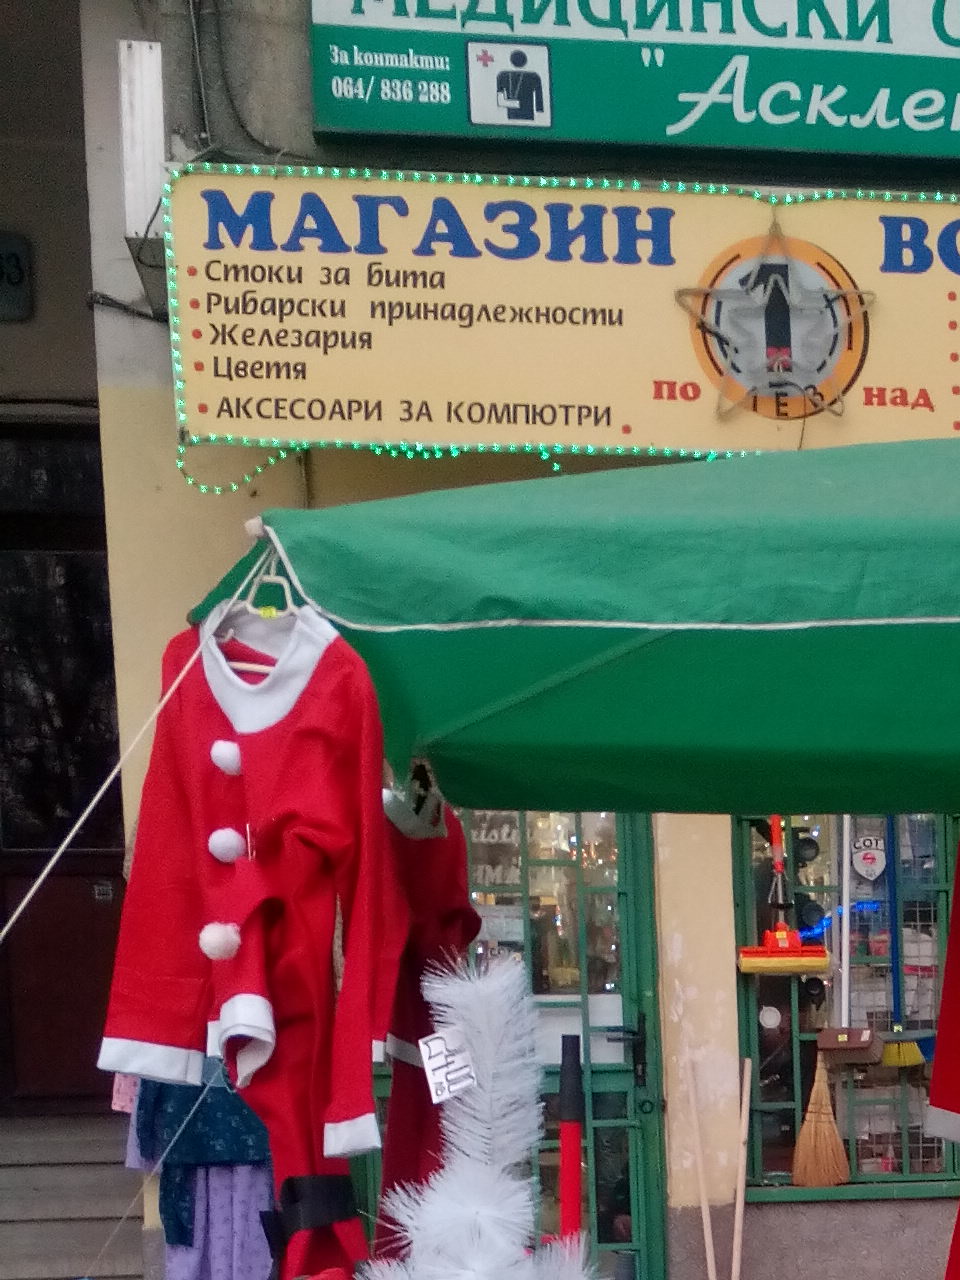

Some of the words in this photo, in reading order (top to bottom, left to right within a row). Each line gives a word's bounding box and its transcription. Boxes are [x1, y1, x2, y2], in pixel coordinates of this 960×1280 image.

[350, 0, 894, 43] ДИЦИНСКИ
[329, 44, 350, 66] За
[353, 44, 451, 71] контакти:
[331, 75, 375, 104] 064/
[380, 78, 414, 102] 836
[418, 80, 452, 105] 288
[200, 189, 677, 267] МАГАЗИН
[204, 260, 303, 286] Стоки
[319, 266, 351, 288] за
[366, 261, 446, 291] бита
[205, 293, 347, 322] Рибарски
[369, 298, 625, 329] принадлежности
[209, 322, 373, 356] Железария
[212, 355, 308, 383] Цветя
[216, 396, 383, 422] АКСЕСОАРИ
[399, 399, 434, 424] ЗА
[446, 400, 612, 428] КОМПЮТРИ
[652, 379, 702, 401] по
[862, 386, 936, 413] над
